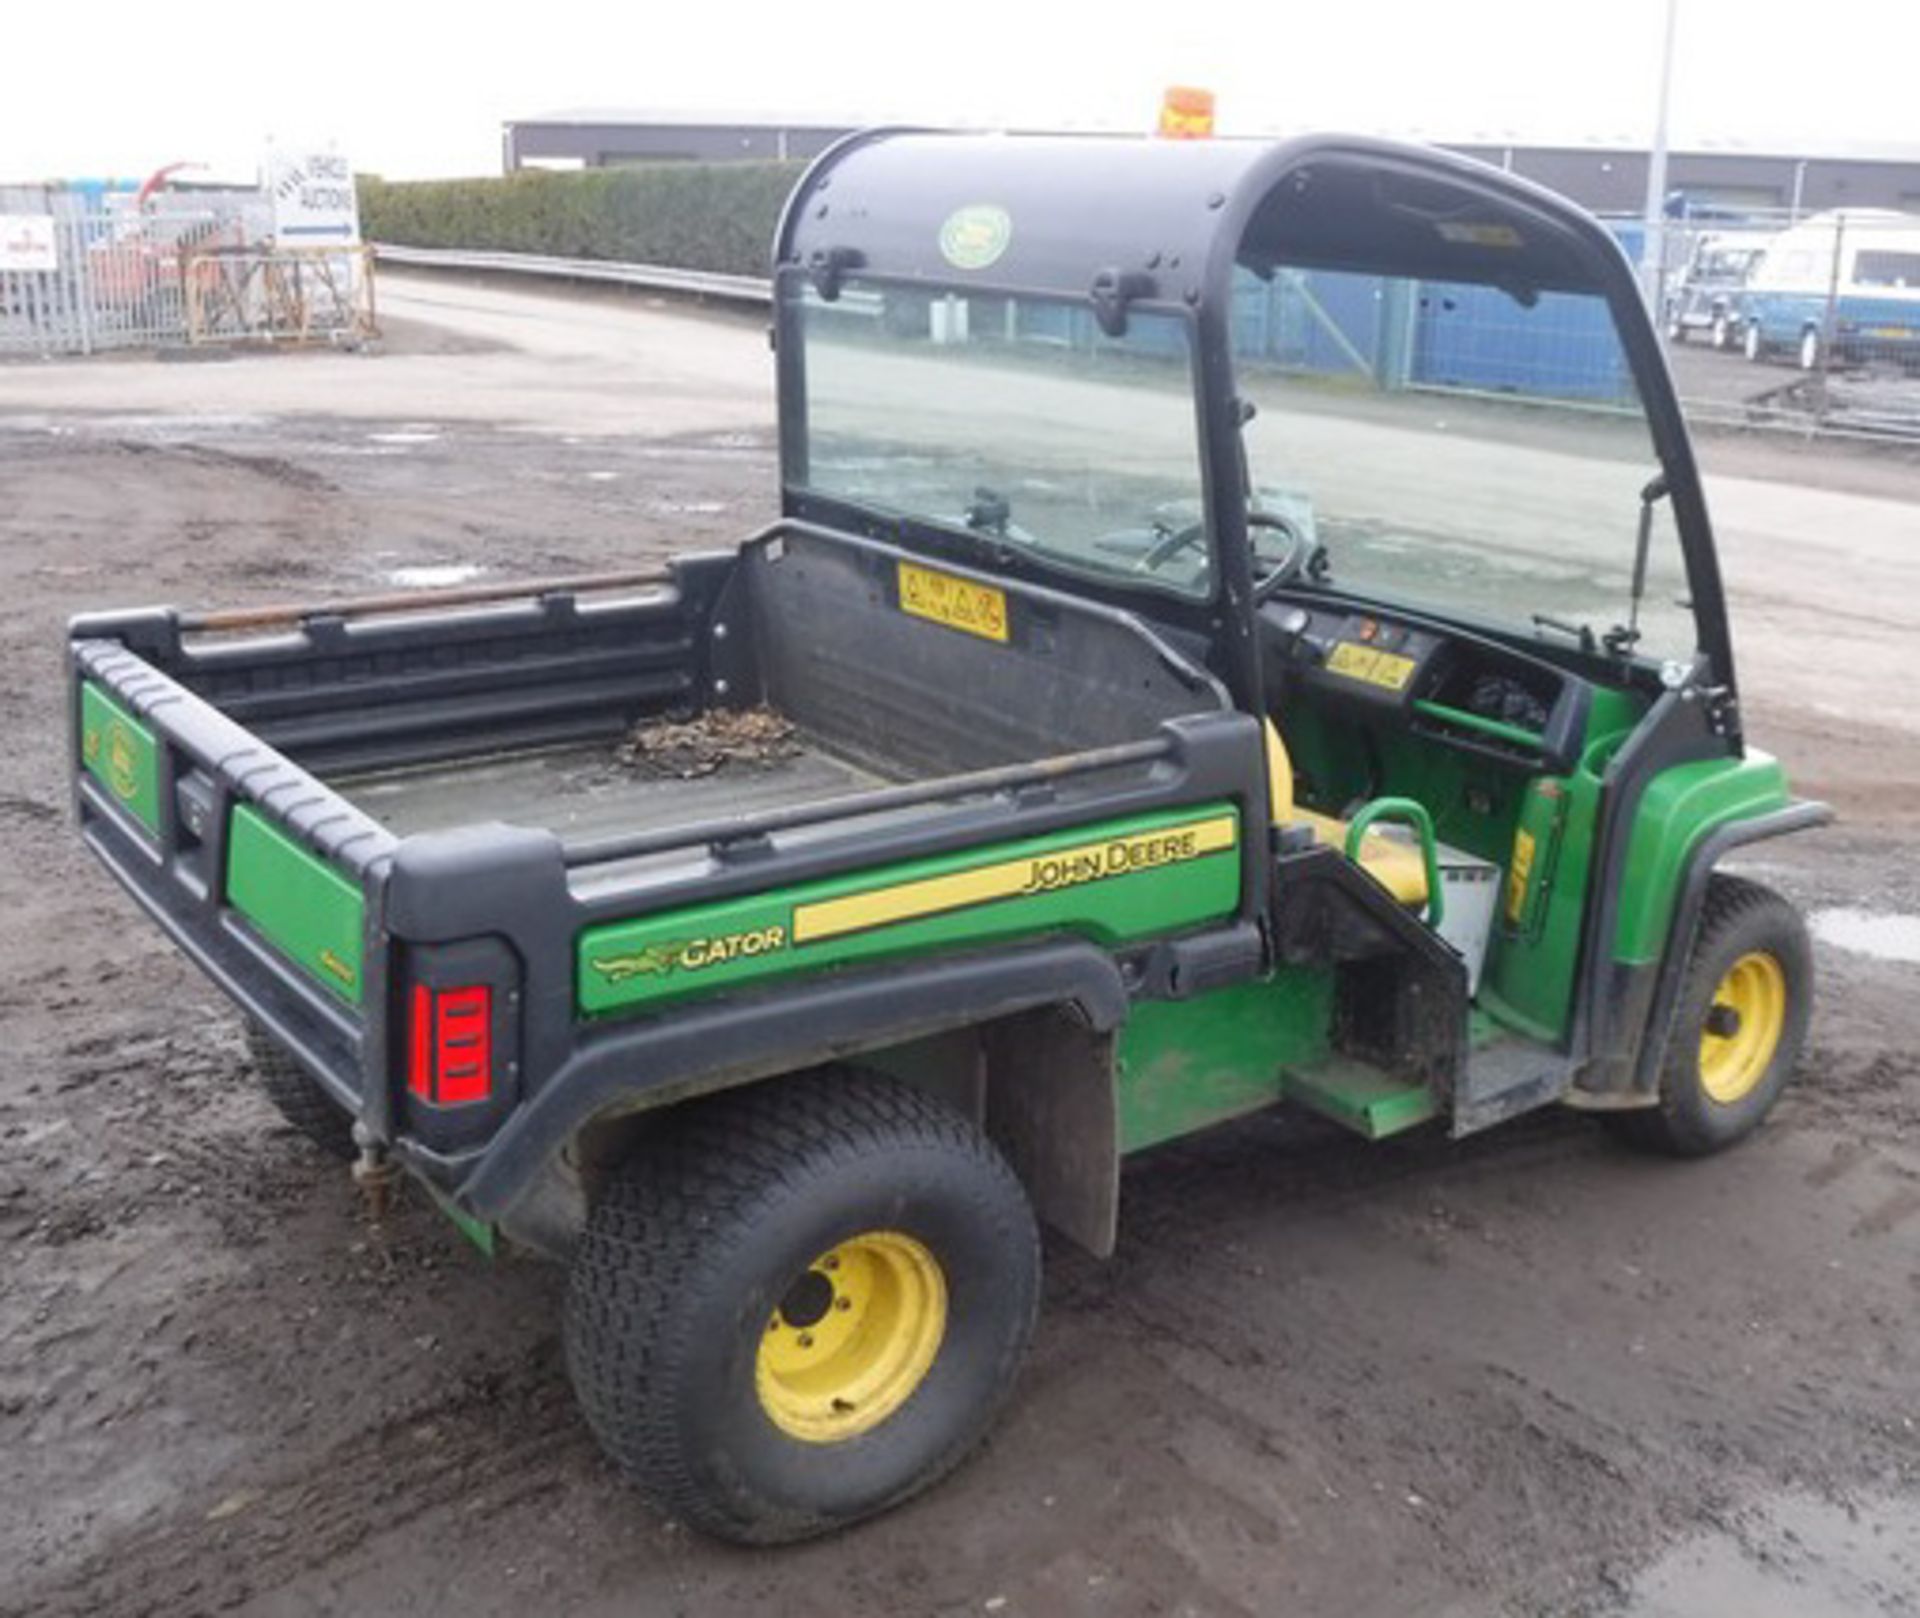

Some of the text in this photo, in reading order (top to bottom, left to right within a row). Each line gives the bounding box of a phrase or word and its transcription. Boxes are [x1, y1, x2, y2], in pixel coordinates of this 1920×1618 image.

[1022, 831, 1197, 890] JOHN DEERE
[681, 926, 784, 969] GATOR
